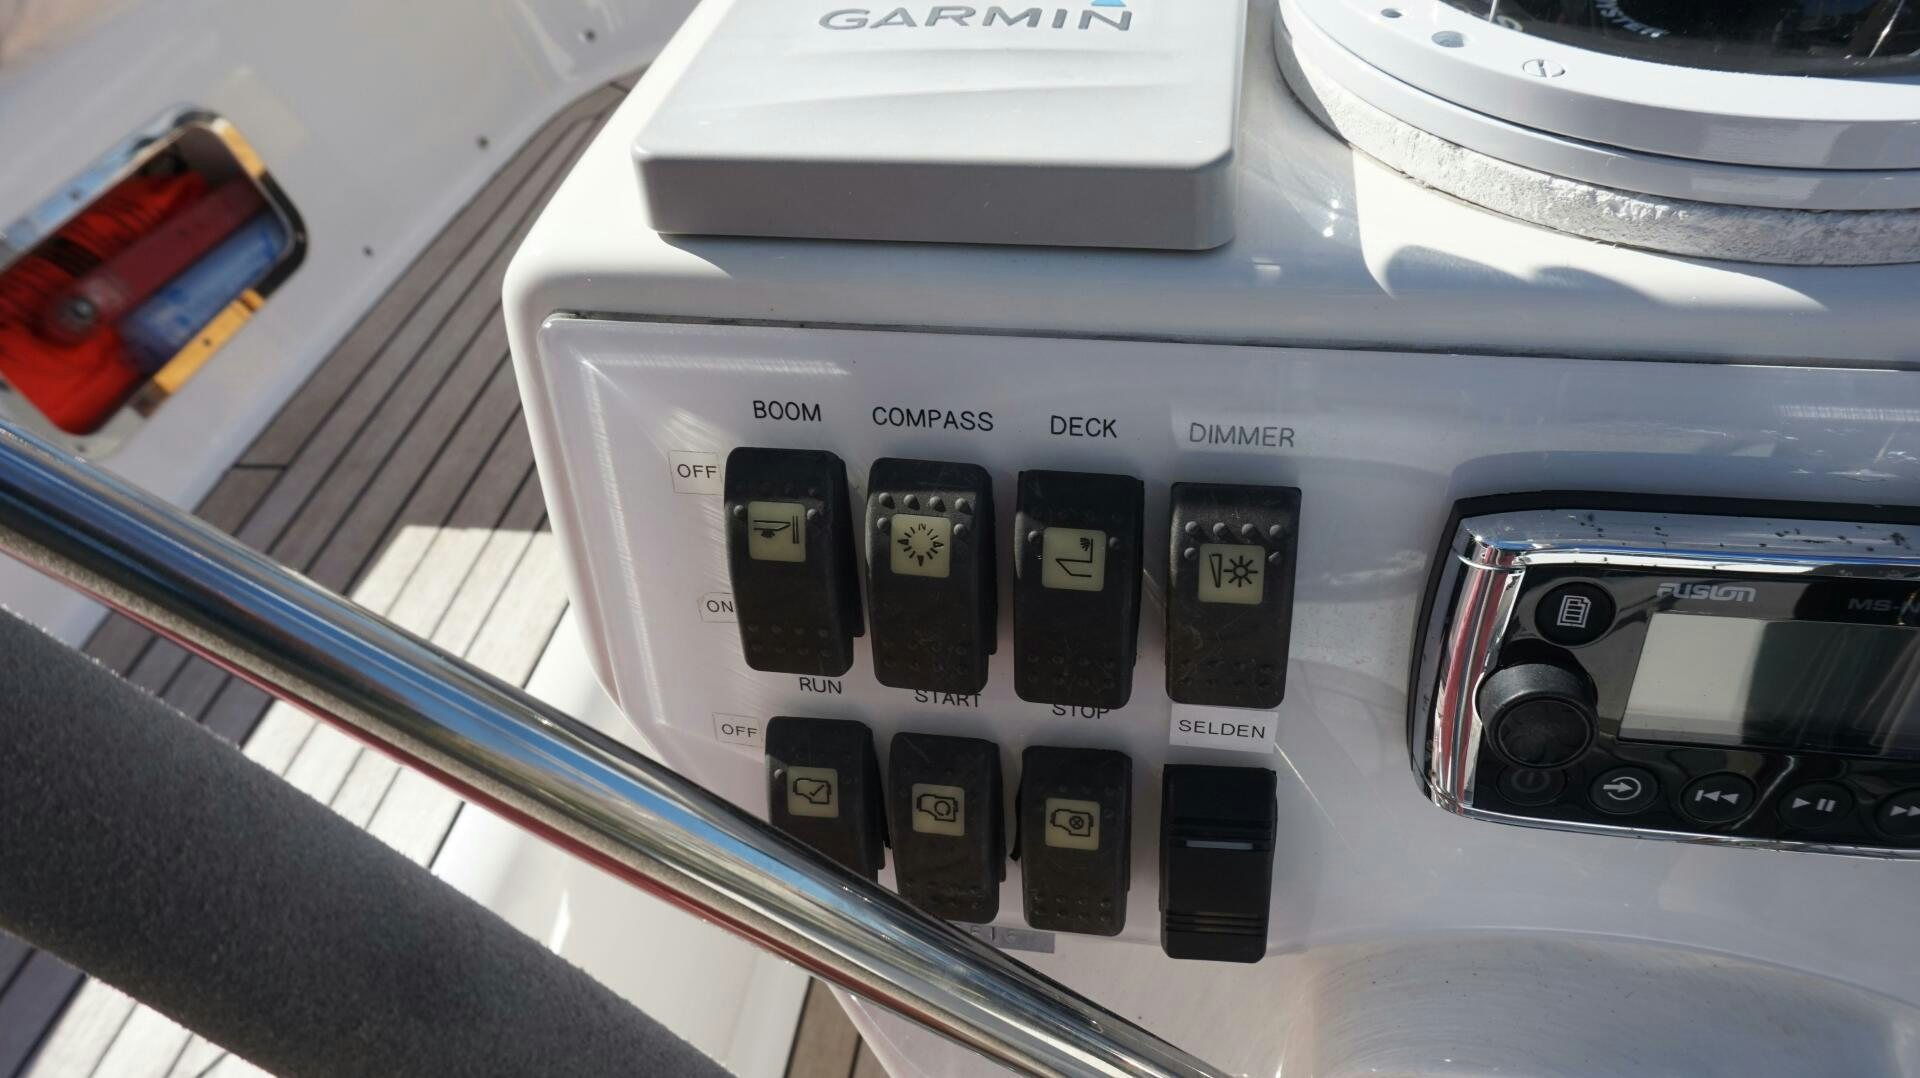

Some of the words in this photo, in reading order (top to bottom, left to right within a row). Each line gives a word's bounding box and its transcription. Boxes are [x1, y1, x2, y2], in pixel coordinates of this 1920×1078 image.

[818, 5, 1133, 31] GARMIN
[753, 400, 821, 422] BOOM
[872, 406, 993, 431] COMPASS
[1050, 415, 1117, 438] DECK
[1189, 422, 1294, 448] DIMMER
[677, 463, 717, 479] OFF
[1656, 582, 1756, 602] FUSION
[706, 600, 734, 613] ON
[799, 677, 842, 695] RUN
[914, 688, 981, 708] START
[721, 723, 757, 738] OFF
[1178, 719, 1266, 739] SELDEN
